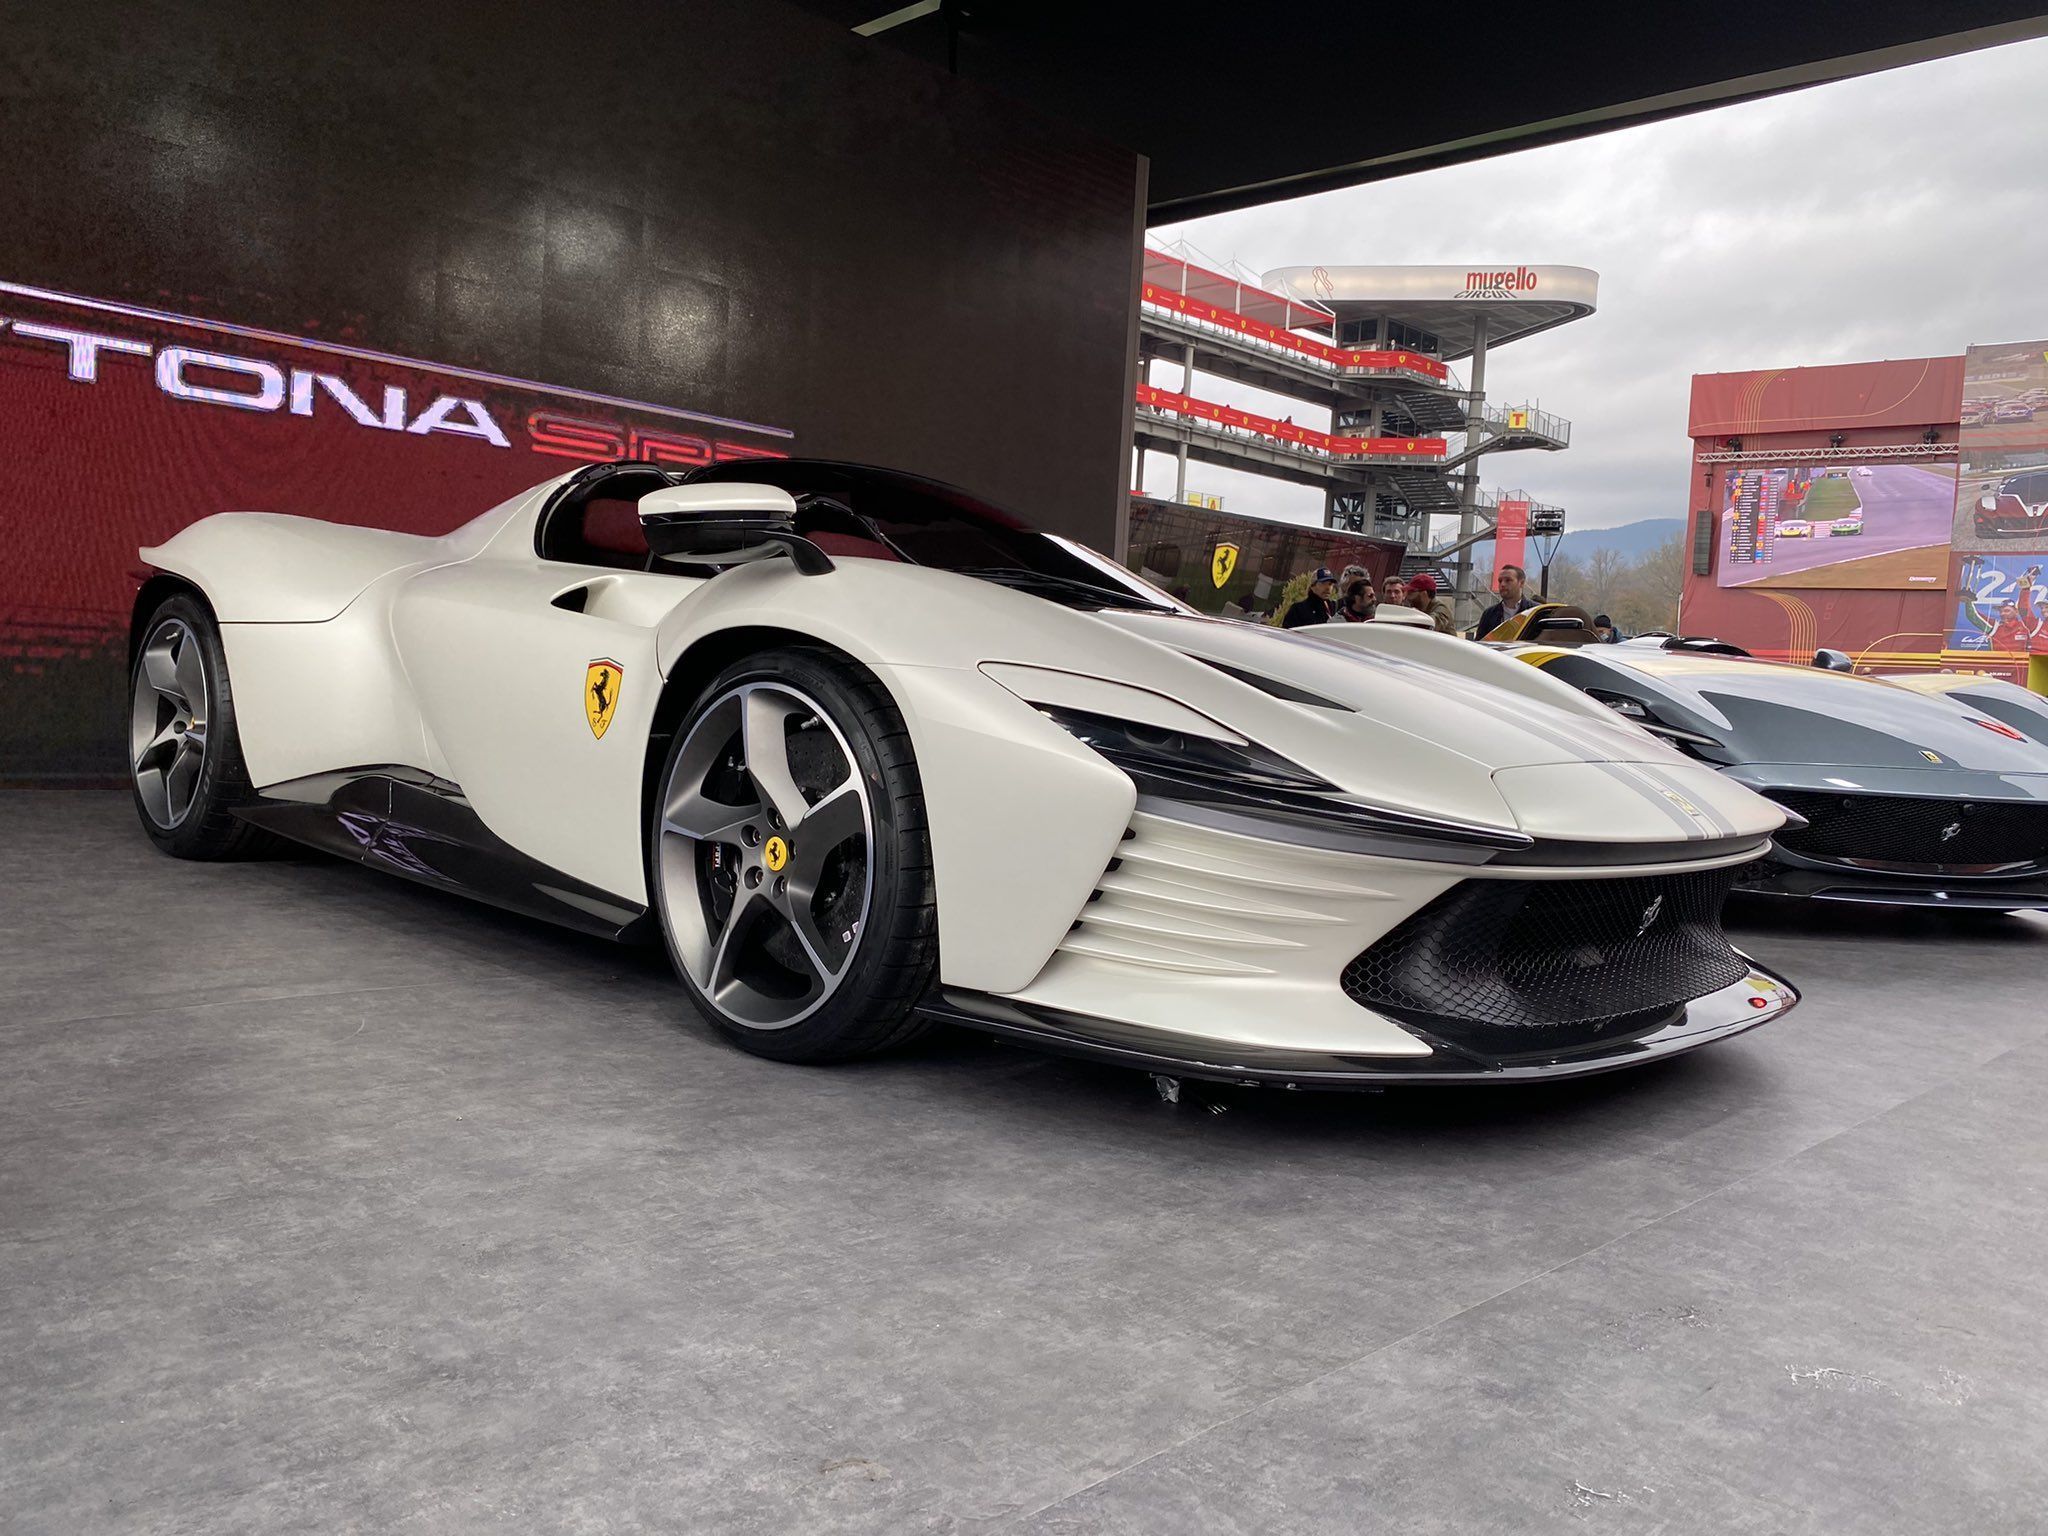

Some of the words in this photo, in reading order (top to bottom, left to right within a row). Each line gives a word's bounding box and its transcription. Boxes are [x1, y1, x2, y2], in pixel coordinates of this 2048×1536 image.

[1465, 266, 1538, 291] mugello
[0, 316, 513, 448] TONA
[1512, 413, 1524, 426] T
